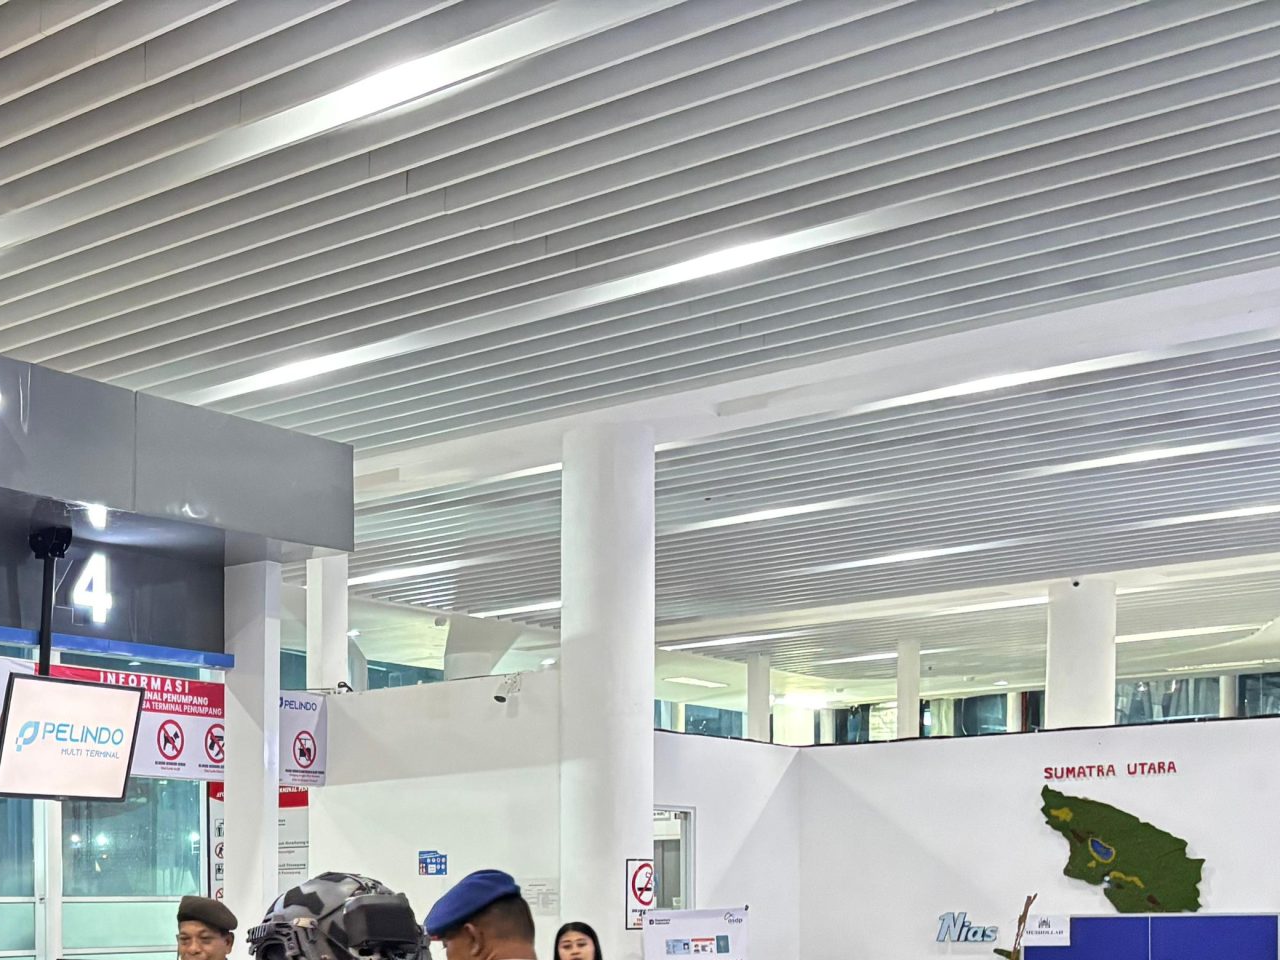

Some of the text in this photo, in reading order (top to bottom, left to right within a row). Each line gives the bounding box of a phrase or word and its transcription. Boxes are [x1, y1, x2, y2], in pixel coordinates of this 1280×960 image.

[73, 552, 113, 624] 4
[99, 671, 190, 694] INFORMASI
[163, 692, 209, 706] PENUMPANG
[283, 699, 318, 712] PELINDO
[151, 702, 183, 713] TERMINAL
[183, 704, 222, 716] PENUMPANG
[41, 721, 125, 746] PELINDO
[60, 748, 120, 760] MULTI TERMINAL
[1043, 761, 1177, 780] SUMATRA UTARA
[936, 912, 999, 943] Nias
